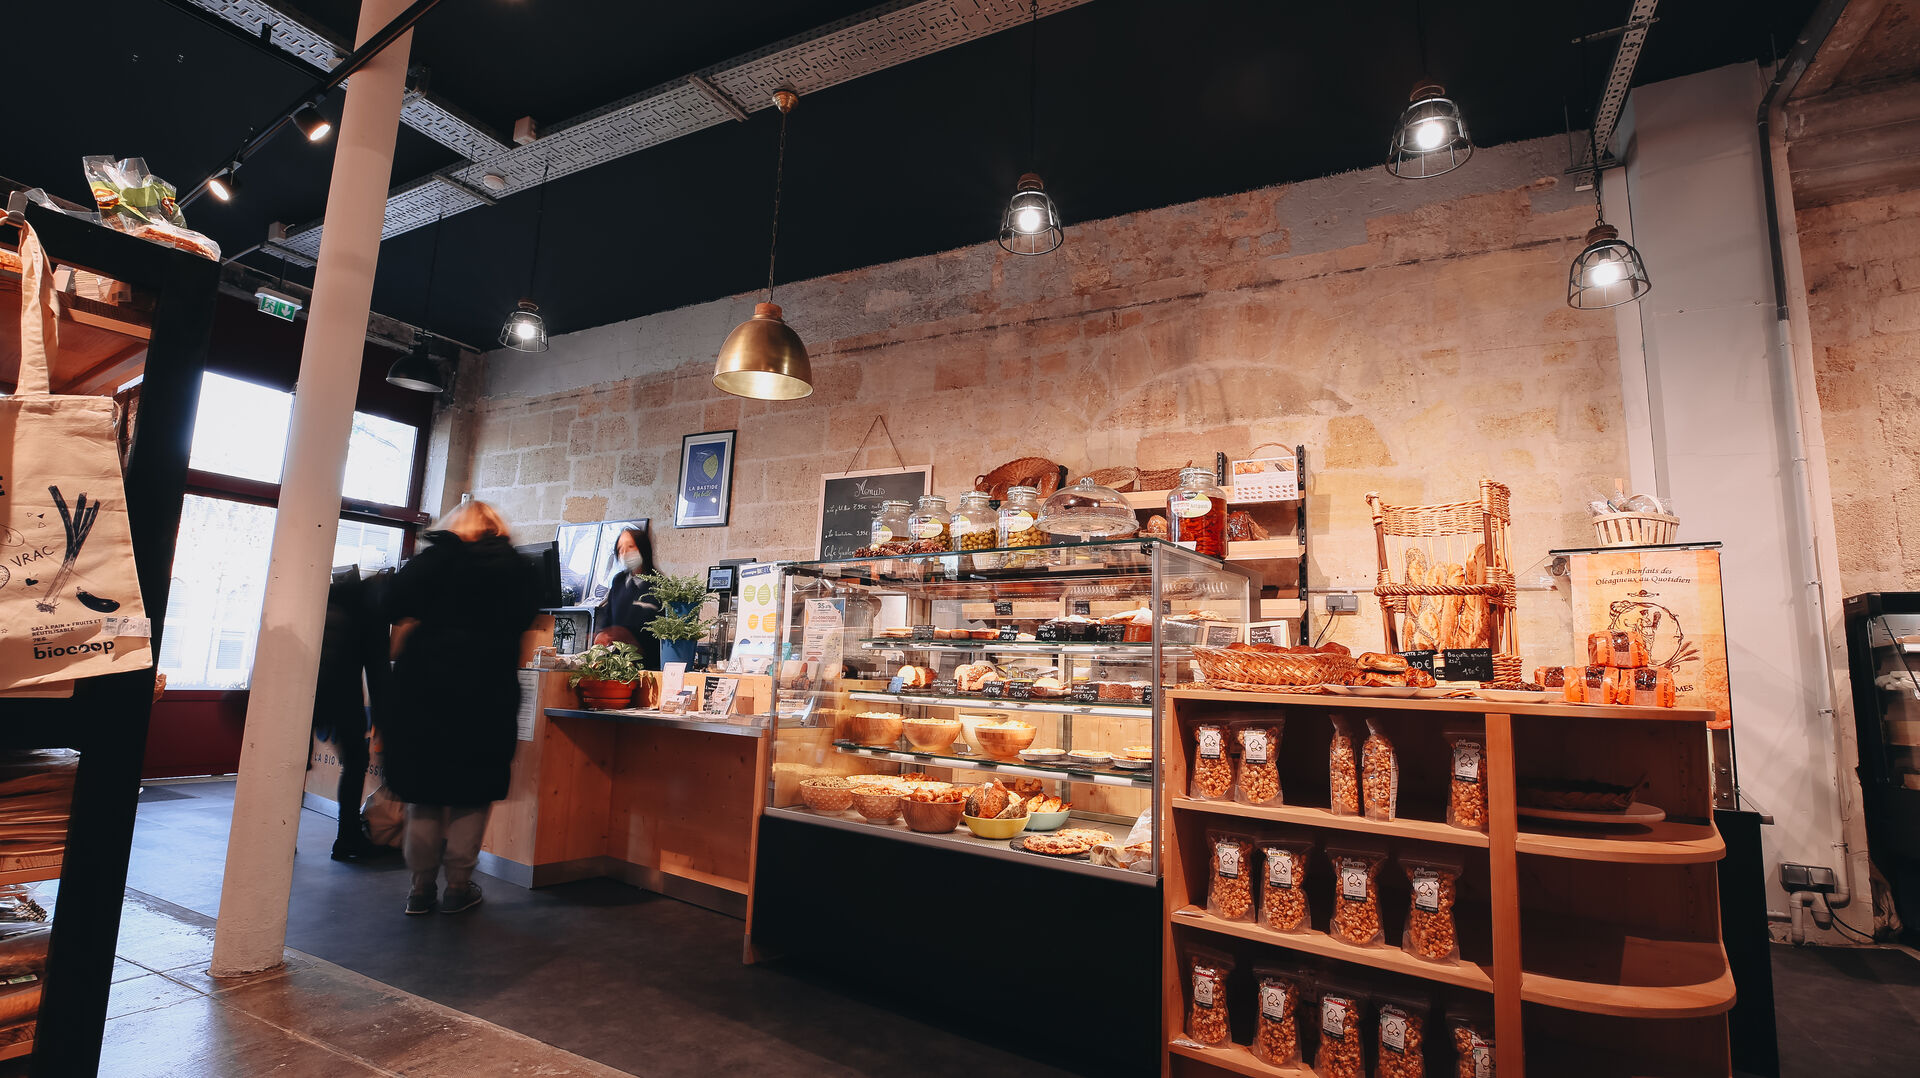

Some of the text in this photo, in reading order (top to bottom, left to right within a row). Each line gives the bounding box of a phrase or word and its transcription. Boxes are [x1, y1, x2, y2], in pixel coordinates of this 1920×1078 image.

[10, 546, 55, 567] VRAC
[1626, 567, 1659, 576] Bienfaits
[1651, 576, 1691, 584] Quotidien
[34, 640, 114, 660] biocoop
[1424, 660, 1431, 669] €
[1675, 684, 1694, 692] MES
[314, 753, 322, 762] LA
[324, 754, 336, 765] BIO
